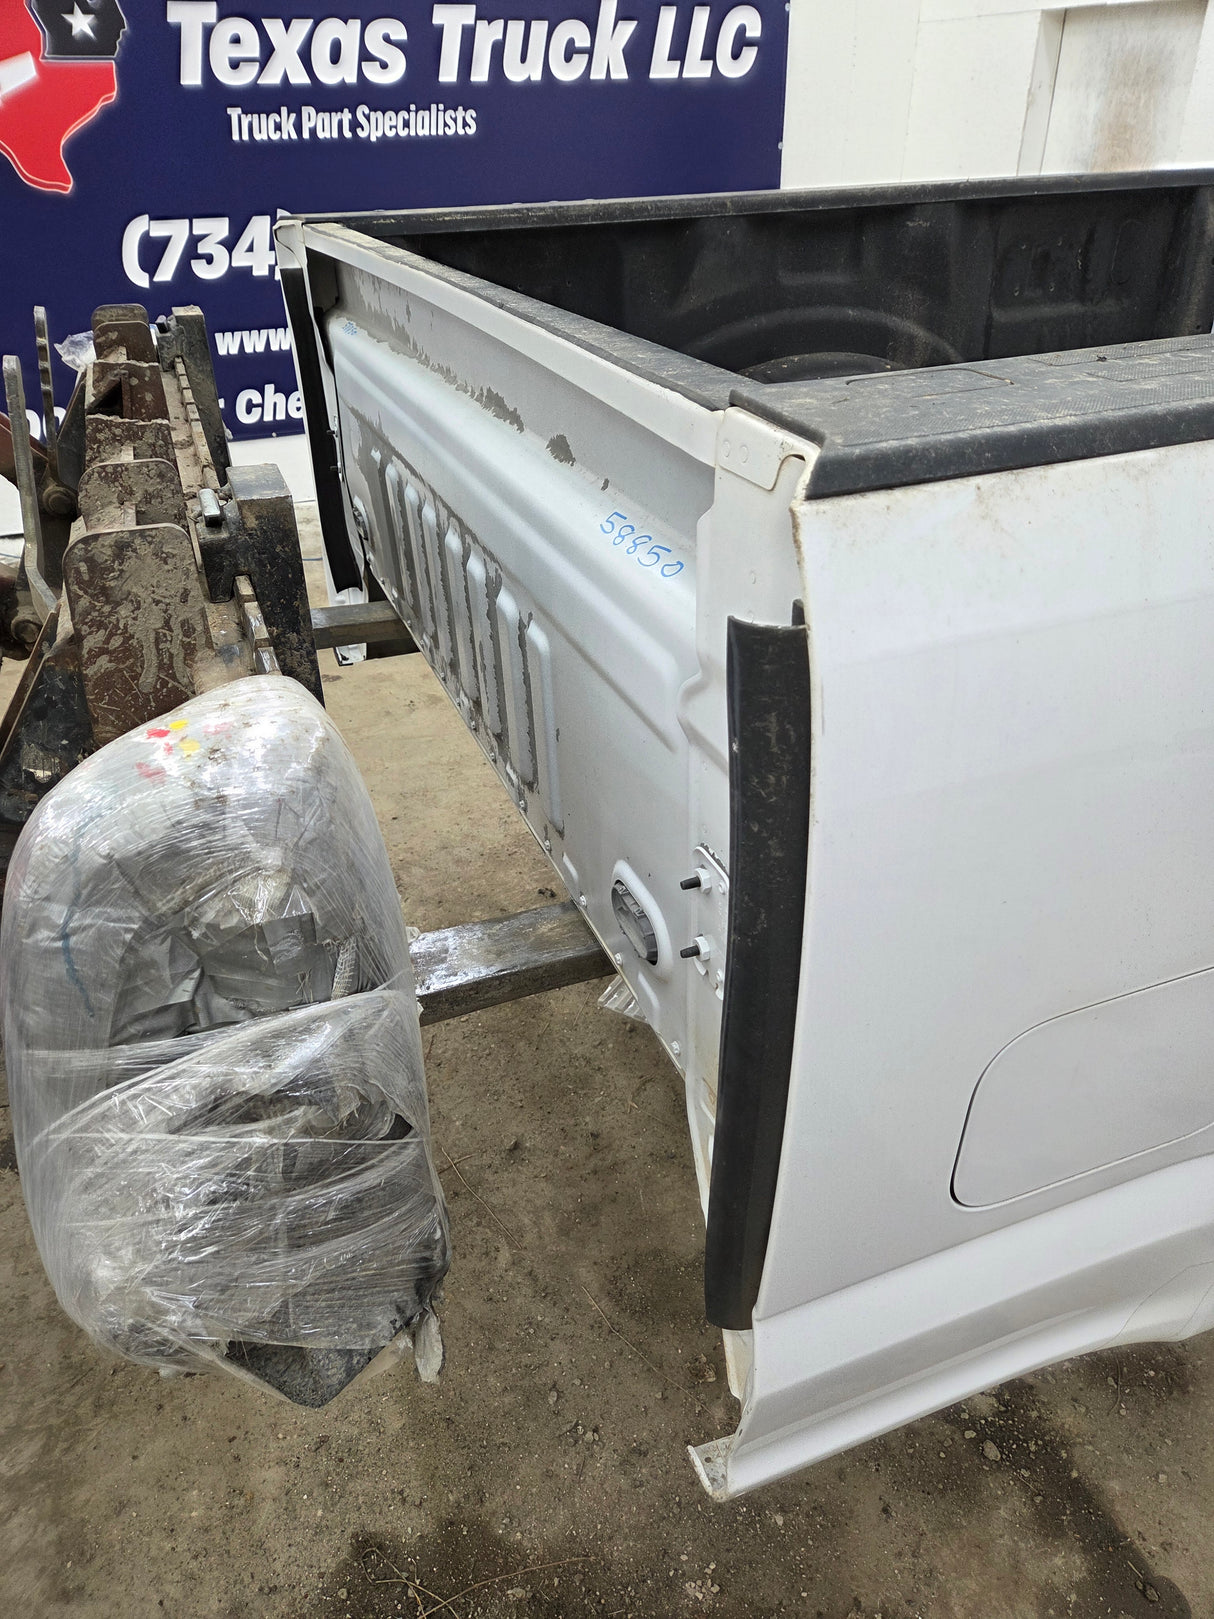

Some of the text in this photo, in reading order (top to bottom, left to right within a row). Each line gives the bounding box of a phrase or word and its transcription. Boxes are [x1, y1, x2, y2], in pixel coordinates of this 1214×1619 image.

[166, 0, 762, 86] Texas Truck LLC
[227, 103, 477, 141] Truck Part Specialists
[600, 511, 684, 578] 58850
